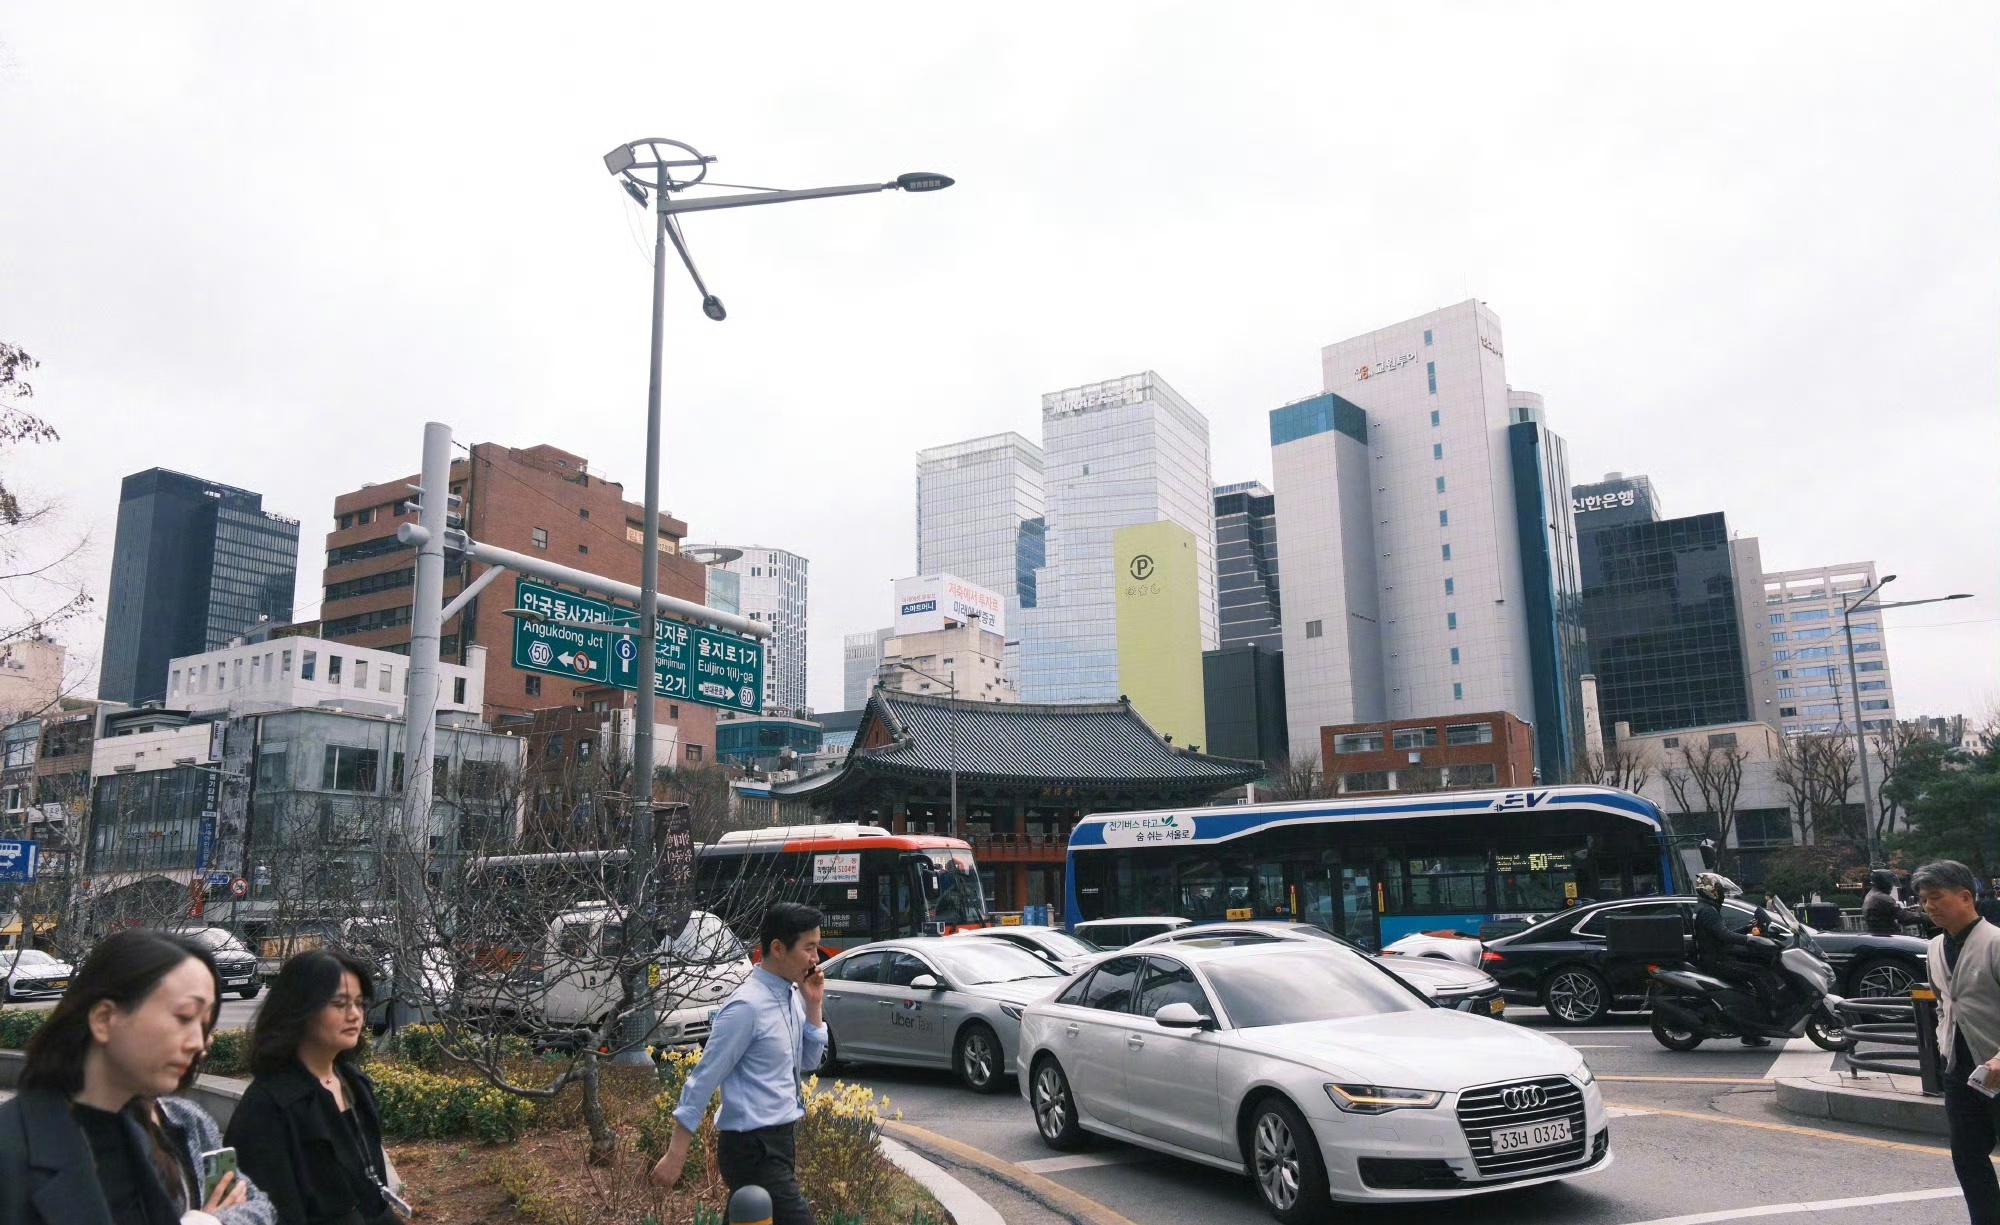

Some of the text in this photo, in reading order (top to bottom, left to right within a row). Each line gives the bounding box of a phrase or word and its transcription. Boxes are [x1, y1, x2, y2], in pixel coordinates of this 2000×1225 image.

[1376, 350, 1418, 374] 교원투어
[1573, 490, 1635, 513] 신한은행
[1137, 559, 1148, 575] P
[523, 592, 606, 624] 안국동사거리
[903, 601, 934, 614] 스마트머니
[949, 583, 999, 612] 저축에서 투자로
[523, 621, 604, 649] Angukdong Jct
[655, 622, 689, 646] 인지문
[533, 645, 549, 660] 50
[621, 643, 630, 657] 6
[698, 637, 758, 668] 을지로1가
[698, 659, 754, 684] Euljiro 1(il)-ga
[654, 673, 687, 695] 로2가
[742, 690, 752, 704] 60
[1504, 791, 1549, 809] EV
[1108, 819, 1158, 832] 전기버스 타고
[1136, 829, 1191, 842] 숨 쉬는 서울로
[891, 1010, 933, 1031] Uber Taxi
[1533, 1123, 1566, 1144] 0323
